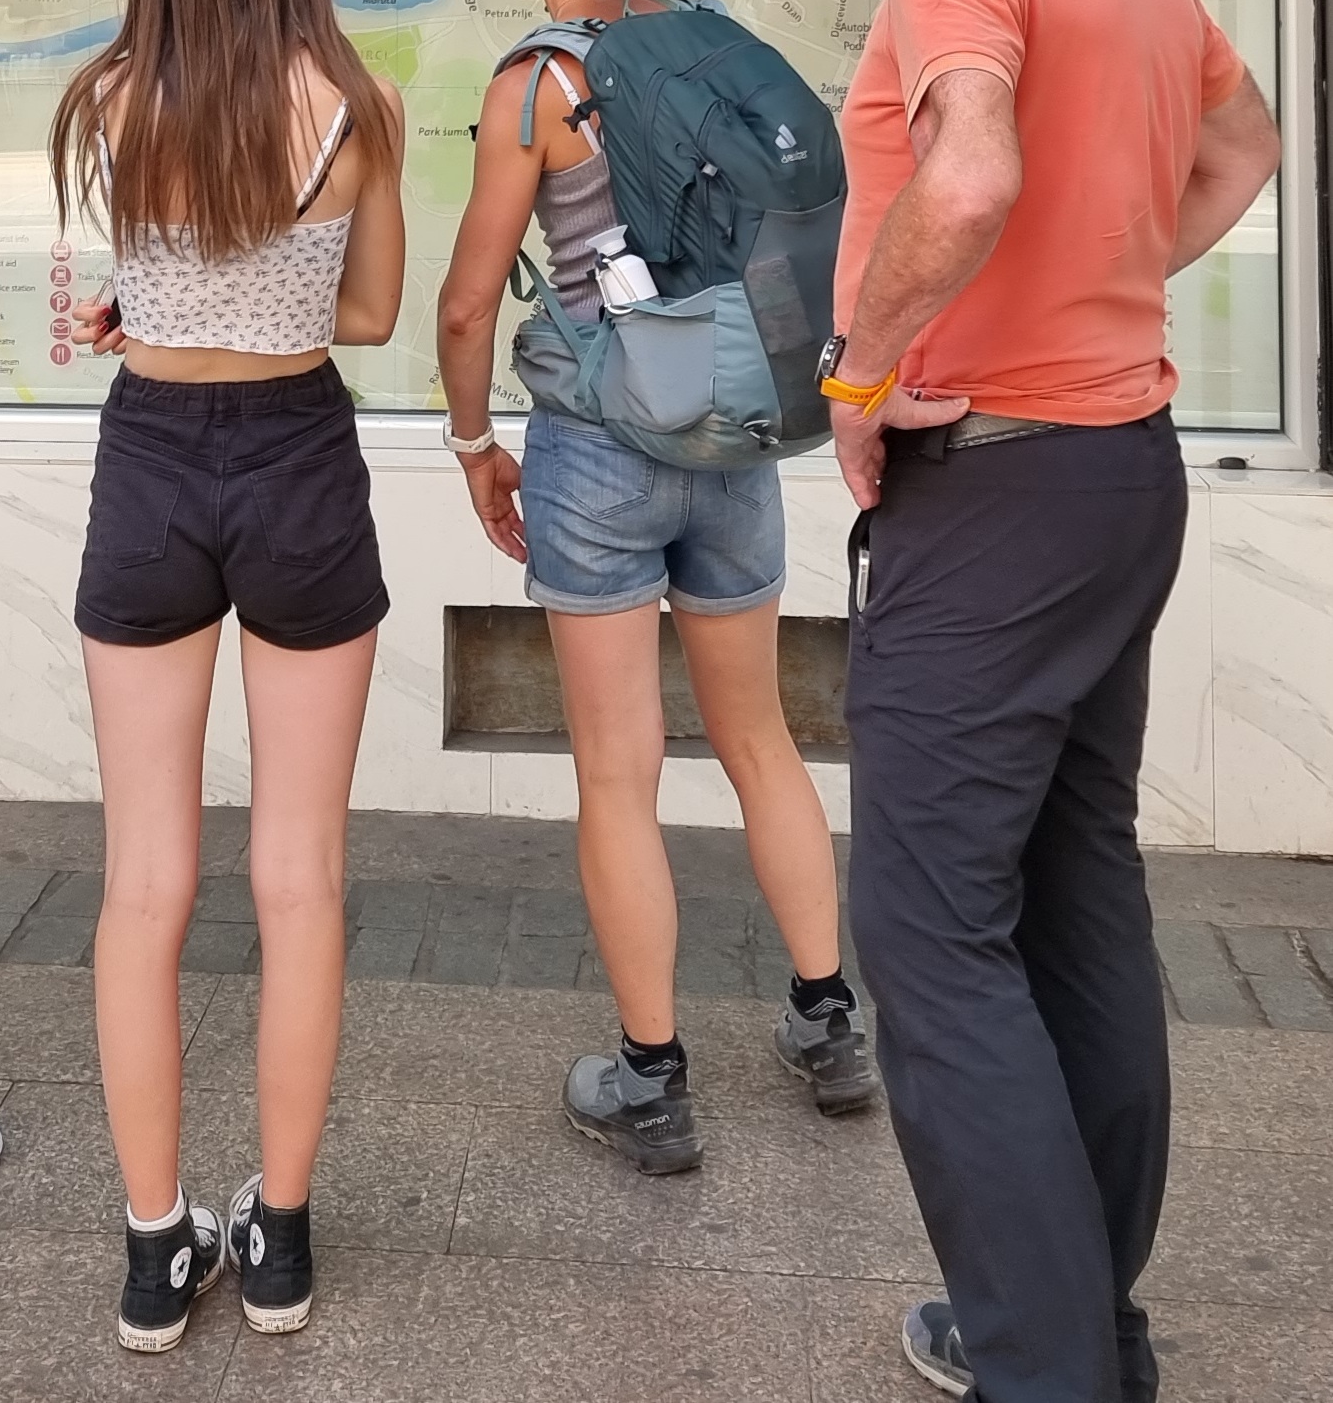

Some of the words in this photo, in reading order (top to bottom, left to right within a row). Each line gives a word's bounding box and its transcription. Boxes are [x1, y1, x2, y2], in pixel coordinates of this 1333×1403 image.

[485, 10, 509, 18] Petra
[781, 1, 802, 23] Džan
[417, 126, 441, 138] Park
[443, 127, 469, 138] šuma
[16, 234, 29, 243] info
[634, 1114, 671, 1130] salomon
